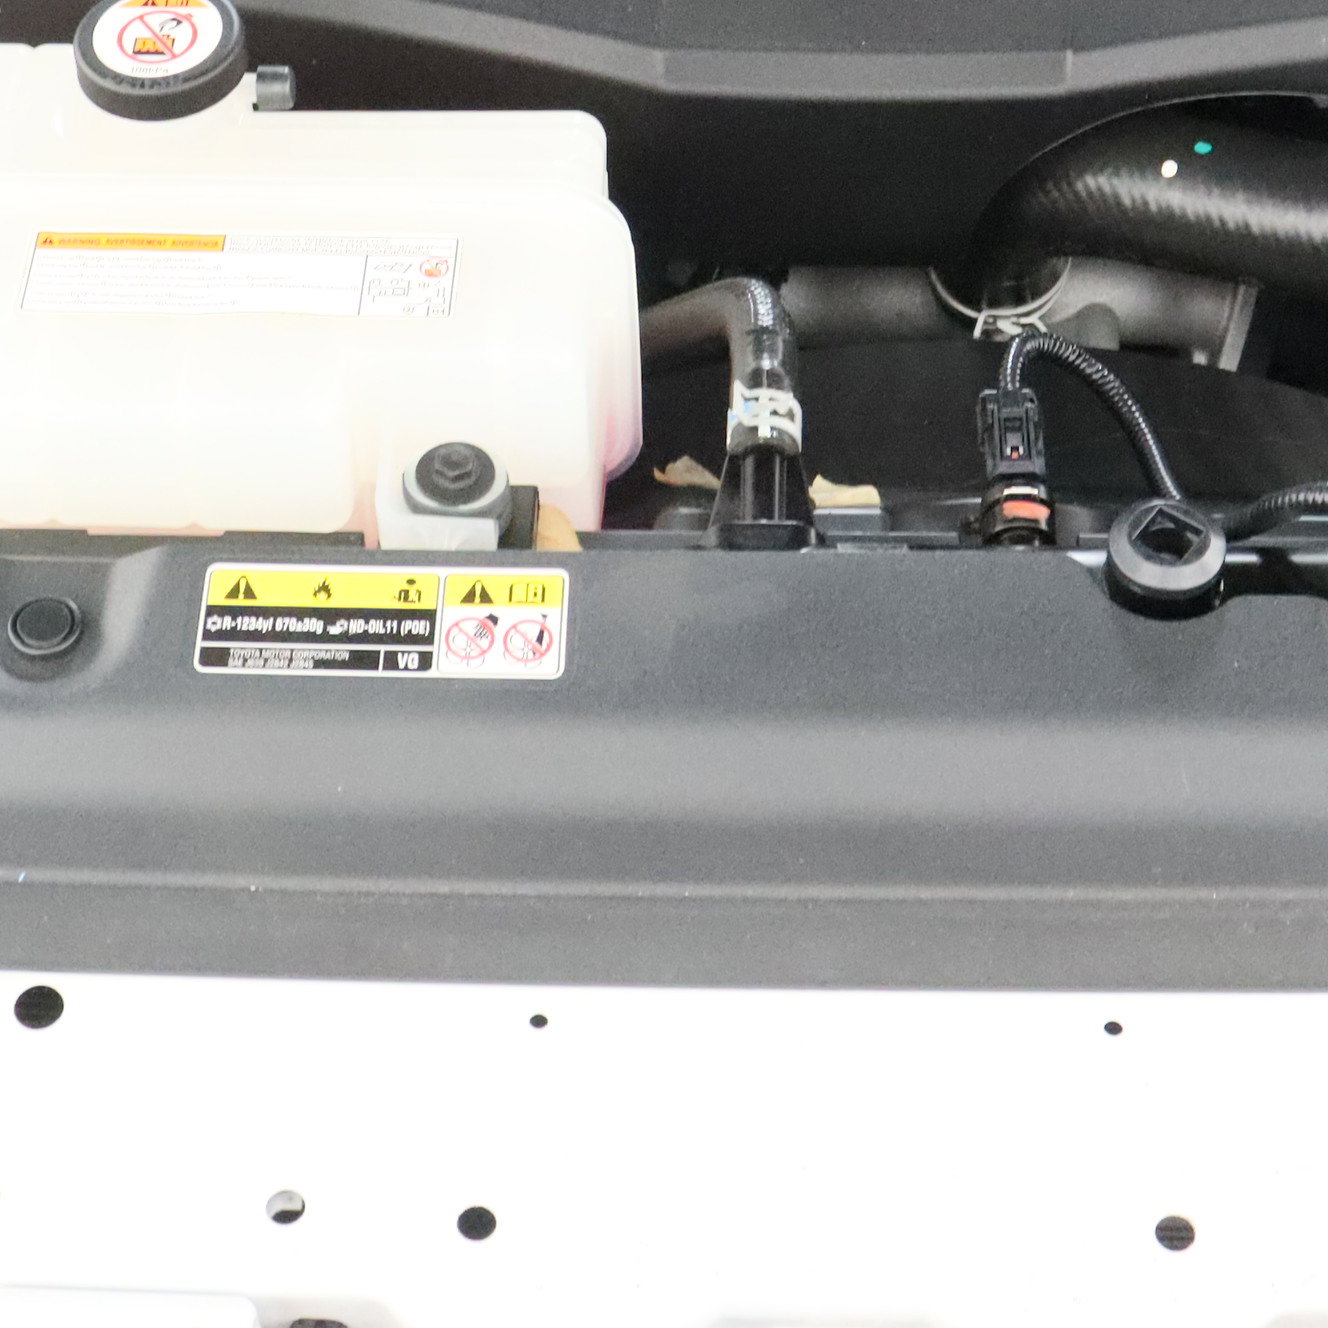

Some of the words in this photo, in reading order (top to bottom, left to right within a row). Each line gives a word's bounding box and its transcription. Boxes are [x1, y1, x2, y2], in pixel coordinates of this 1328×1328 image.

[222, 615, 274, 634] R-1234yf
[229, 648, 261, 660] TOYOTA
[261, 648, 292, 660] MOTOR
[292, 649, 350, 662] CORPORATION
